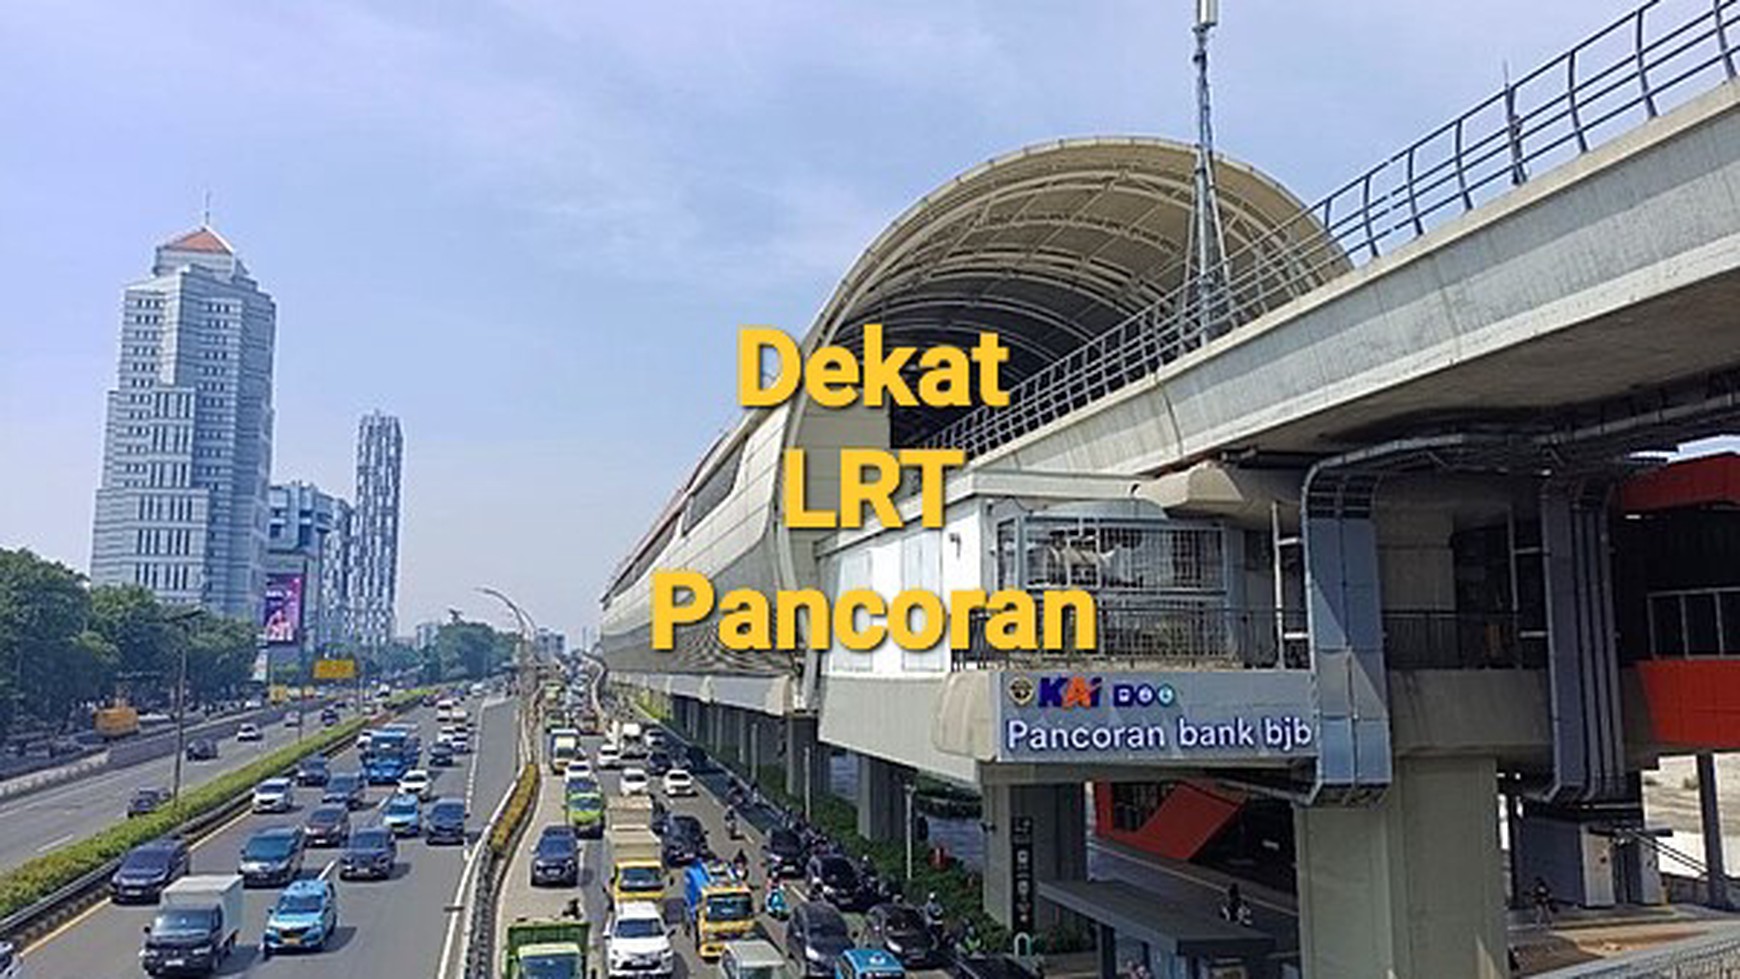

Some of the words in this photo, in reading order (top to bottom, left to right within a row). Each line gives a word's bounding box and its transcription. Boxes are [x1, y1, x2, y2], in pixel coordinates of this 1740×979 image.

[1007, 719, 1165, 750] Pancoran
[1178, 717, 1254, 746] bank
[1265, 717, 1312, 751] bjb
